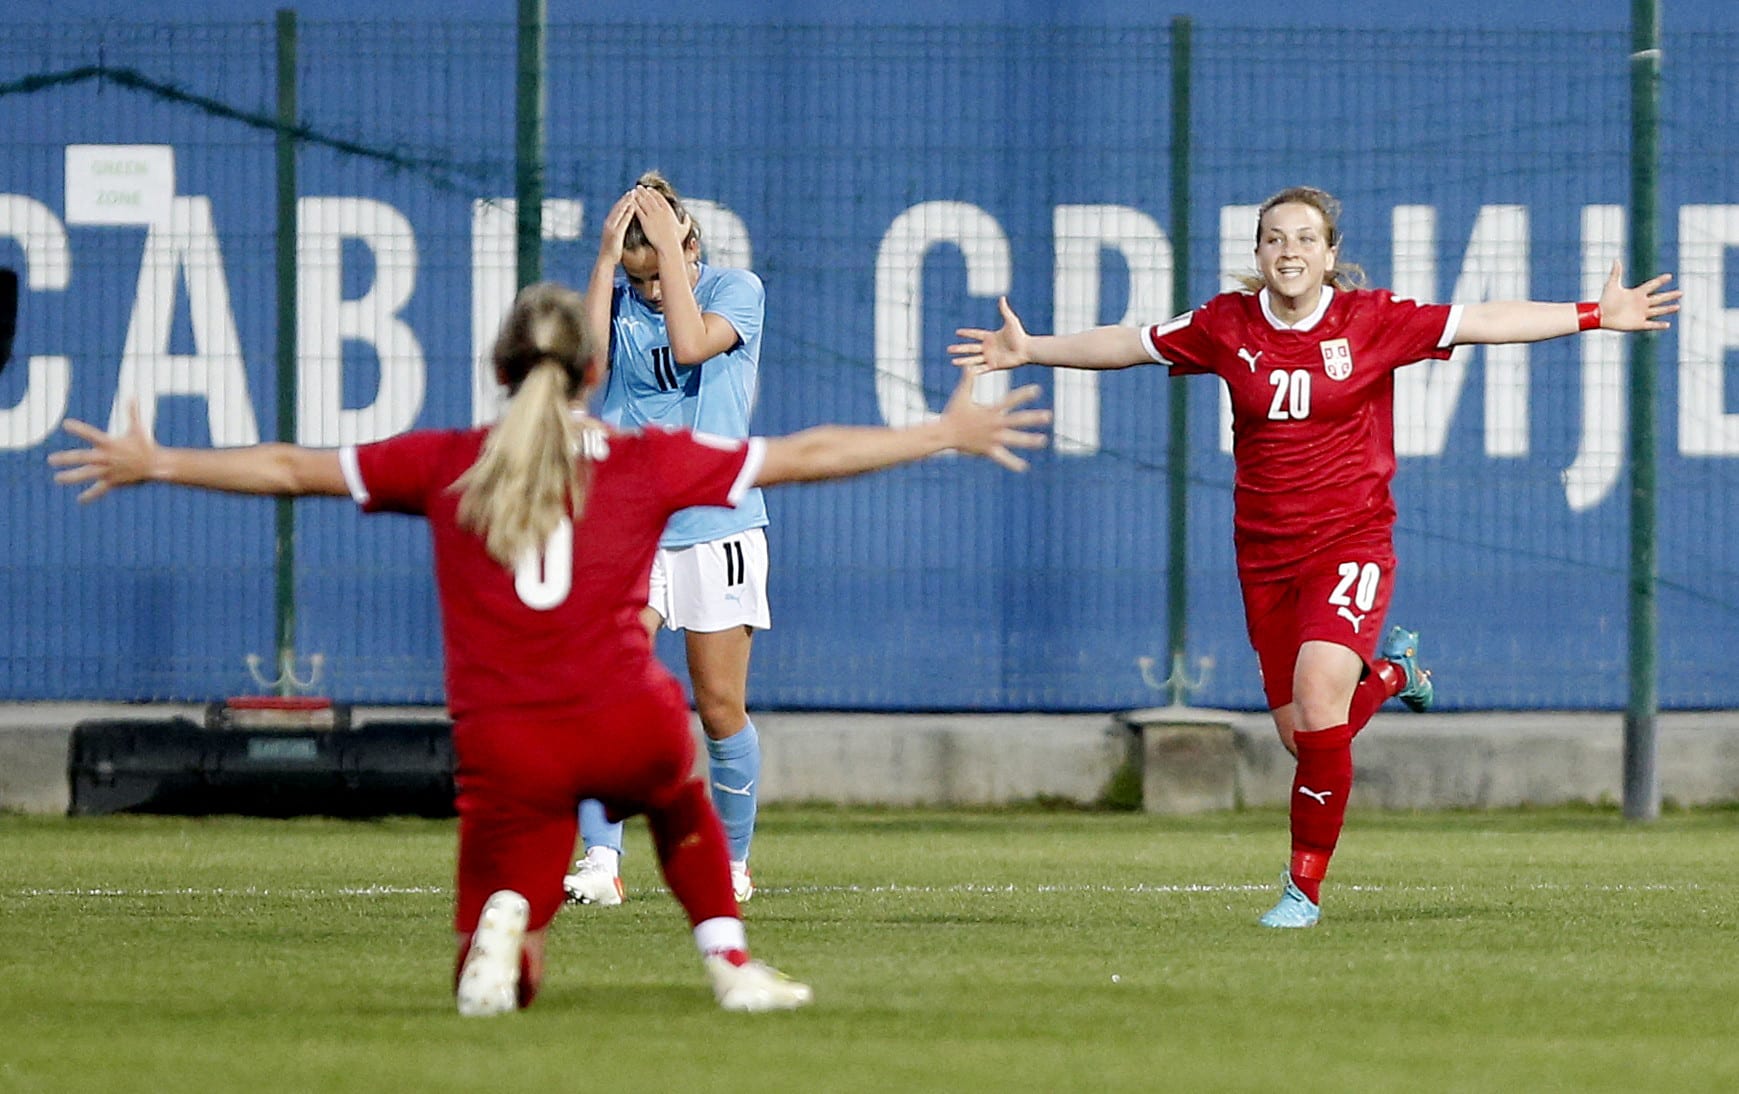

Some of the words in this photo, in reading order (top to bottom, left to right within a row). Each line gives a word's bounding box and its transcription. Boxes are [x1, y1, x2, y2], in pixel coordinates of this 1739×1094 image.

[95, 189, 142, 206] ZONE
[653, 347, 681, 391] 11
[1268, 369, 1311, 420] 20
[723, 540, 745, 587] 11
[1328, 561, 1381, 612] 20
